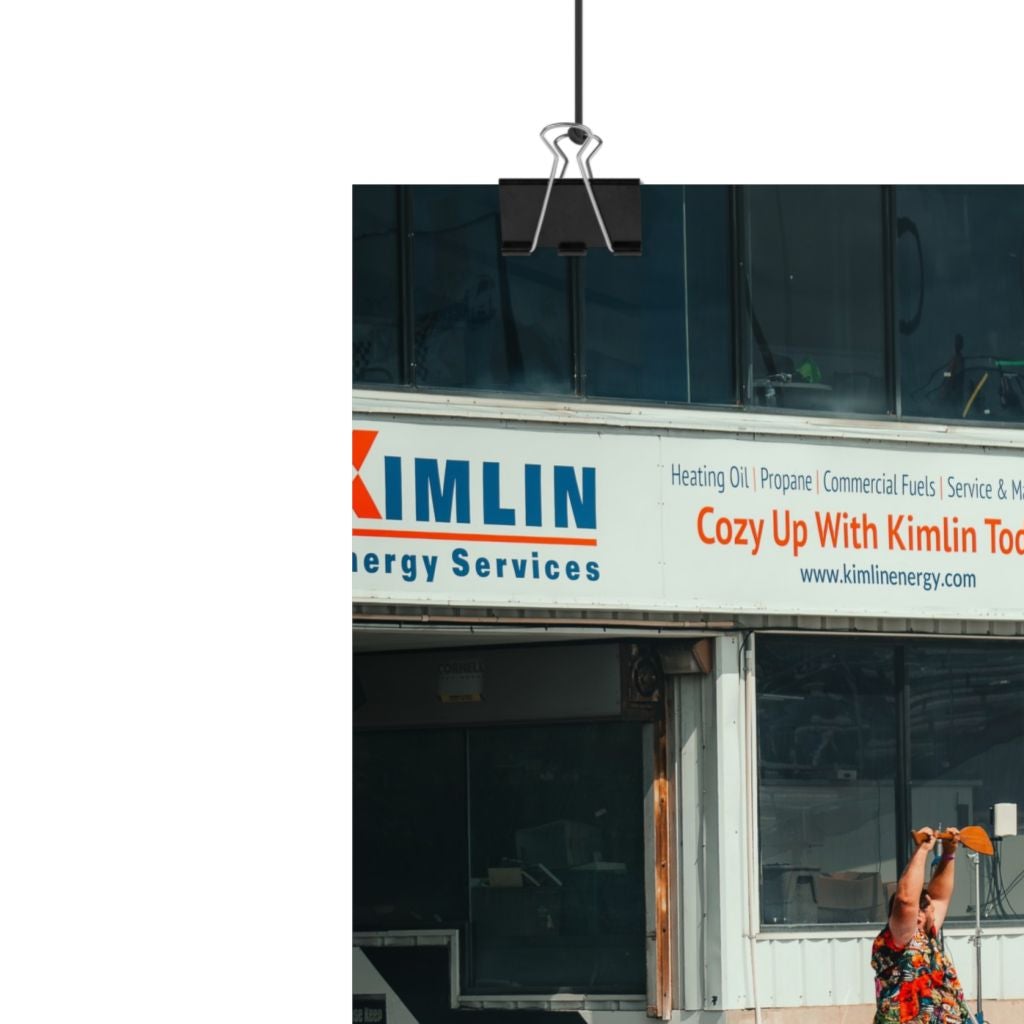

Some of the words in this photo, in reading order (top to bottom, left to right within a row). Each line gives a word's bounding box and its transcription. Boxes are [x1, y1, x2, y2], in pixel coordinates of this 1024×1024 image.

[671, 464, 725, 493] Heating
[730, 465, 749, 489] Oil
[760, 467, 812, 495] Propane
[823, 470, 898, 496] Commercial
[901, 474, 935, 498] Fuels
[947, 477, 992, 500] Service
[997, 479, 1008, 500] &
[697, 506, 764, 556] Cozy
[772, 509, 808, 557] Up
[815, 511, 878, 550] With
[888, 514, 977, 554] Kimlin
[452, 548, 600, 582] Services
[800, 563, 977, 592] www.kimlinenergy.com
